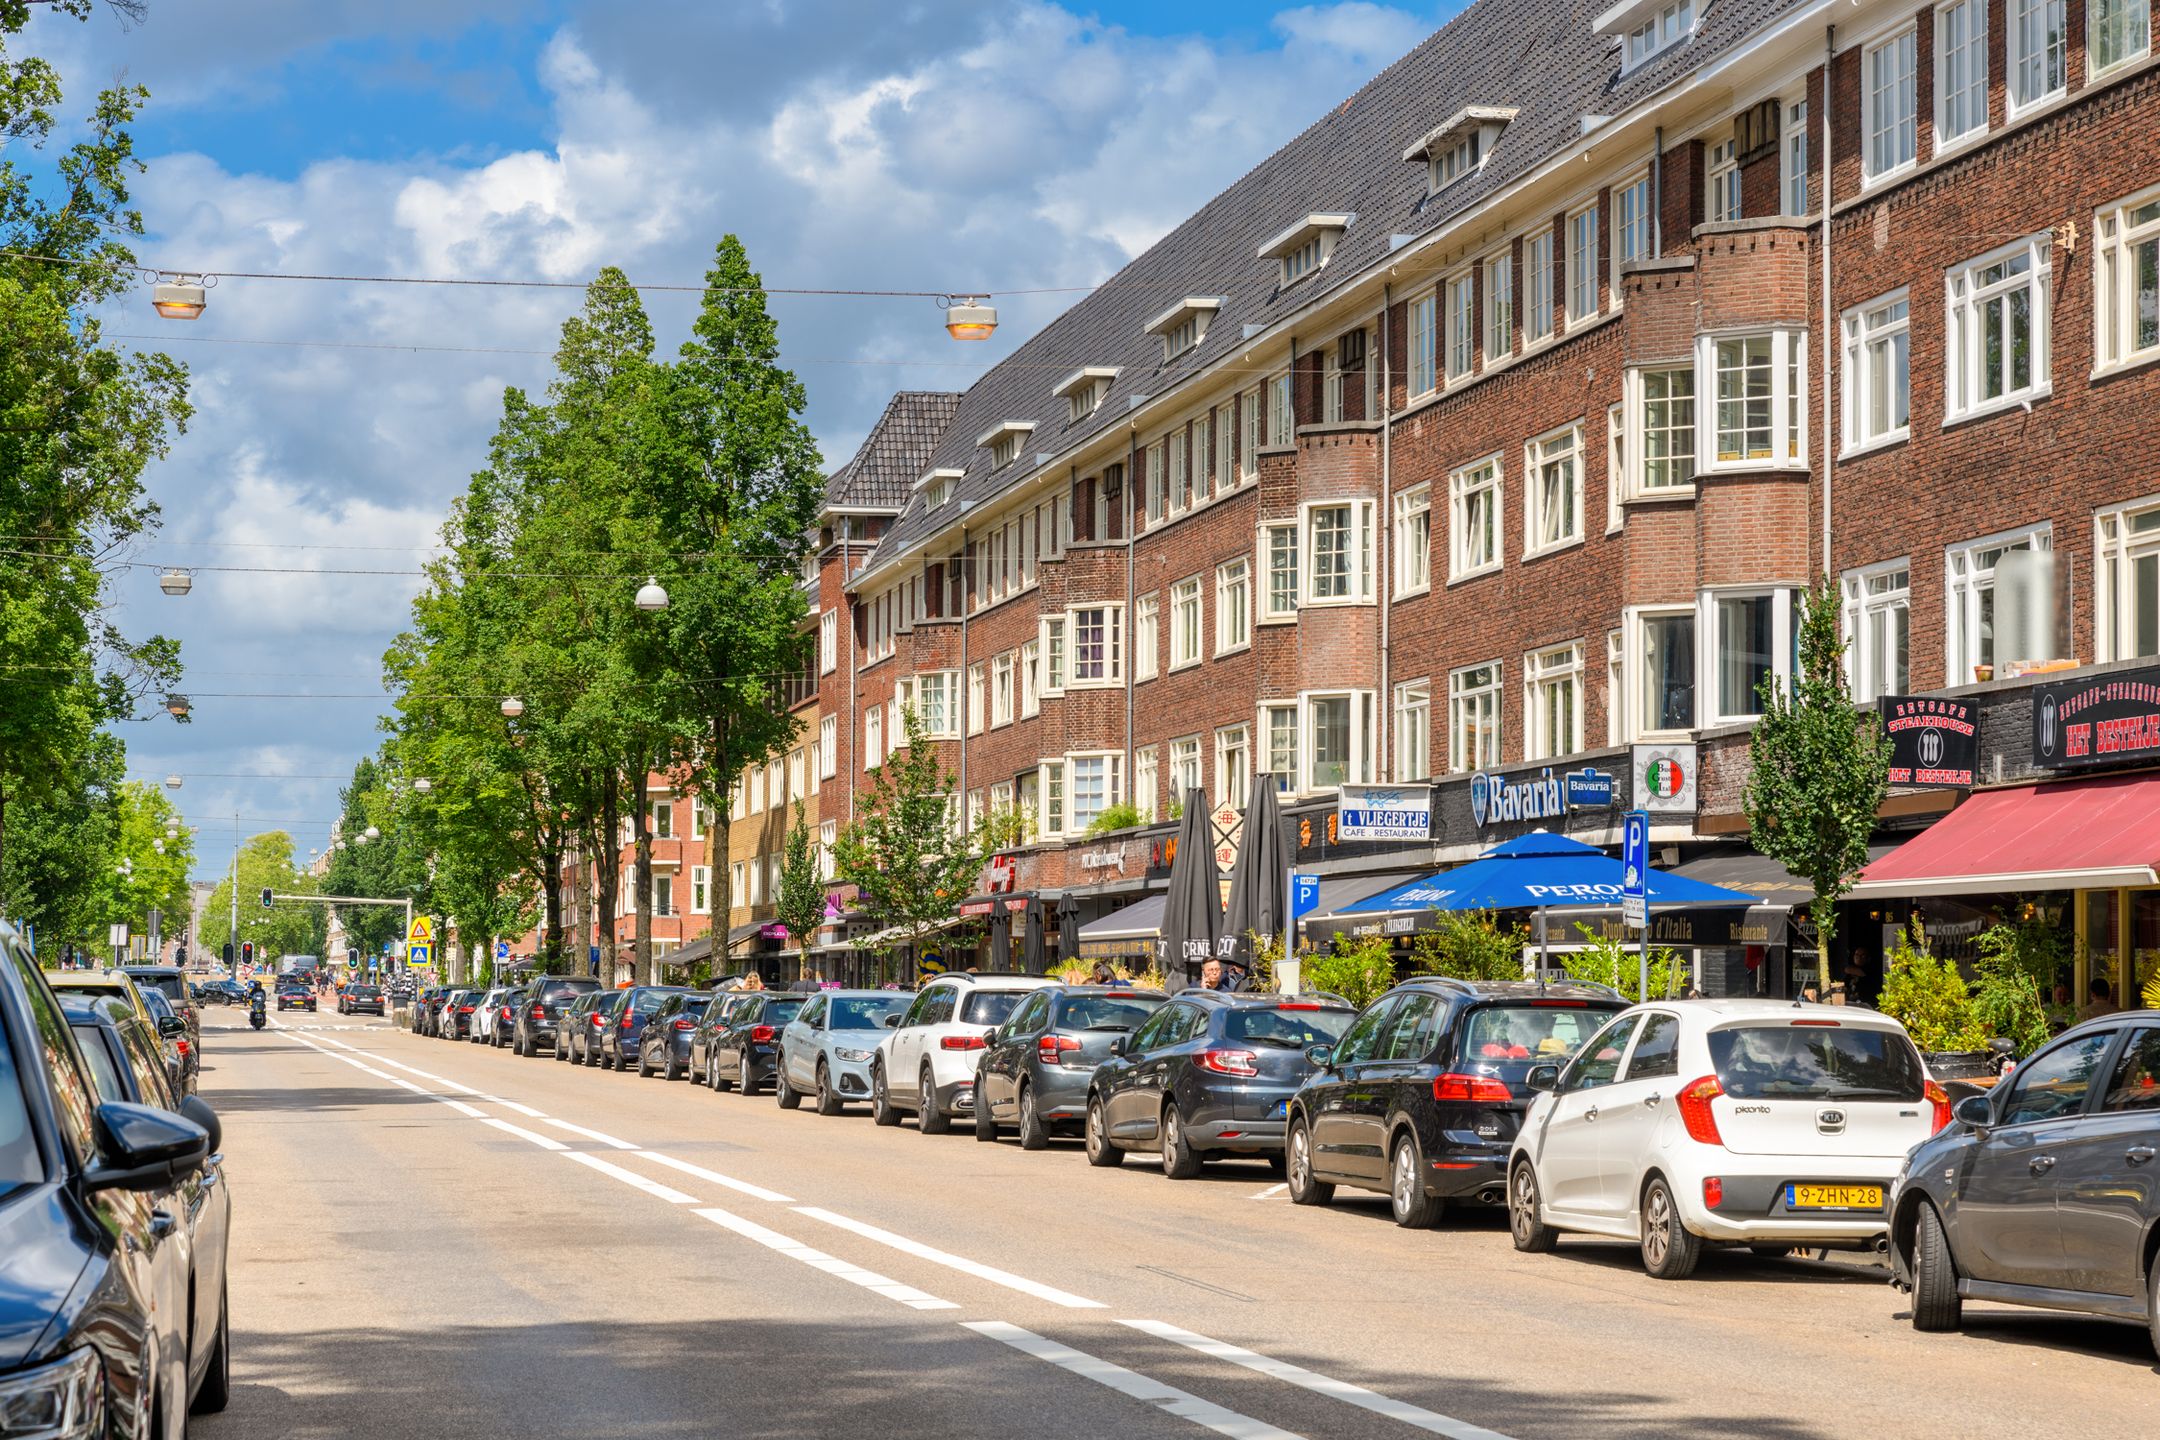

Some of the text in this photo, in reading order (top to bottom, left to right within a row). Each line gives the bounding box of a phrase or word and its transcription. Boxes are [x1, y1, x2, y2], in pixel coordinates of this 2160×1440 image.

[1896, 701, 1967, 719] EETCAFE
[1888, 716, 1975, 736] STEAKHOUSE
[2066, 714, 2160, 757] HET BESTEKJE
[1888, 768, 1972, 784] HET BESTEKJE
[1570, 780, 1610, 791] Bavaria
[1487, 767, 1561, 824] Bavaria
[1344, 811, 1427, 827] 't VLIEGERTJE
[1344, 828, 1427, 838] CAFE RESTAURANT
[1629, 821, 1641, 861] P
[1301, 887, 1311, 904] P
[1656, 917, 1693, 939] d'Italia
[1730, 923, 1768, 940] Ristorante
[1735, 1106, 1771, 1115] picanto
[1822, 1113, 1841, 1122] KIA
[1800, 1187, 1877, 1204] 9-ZHN-28
